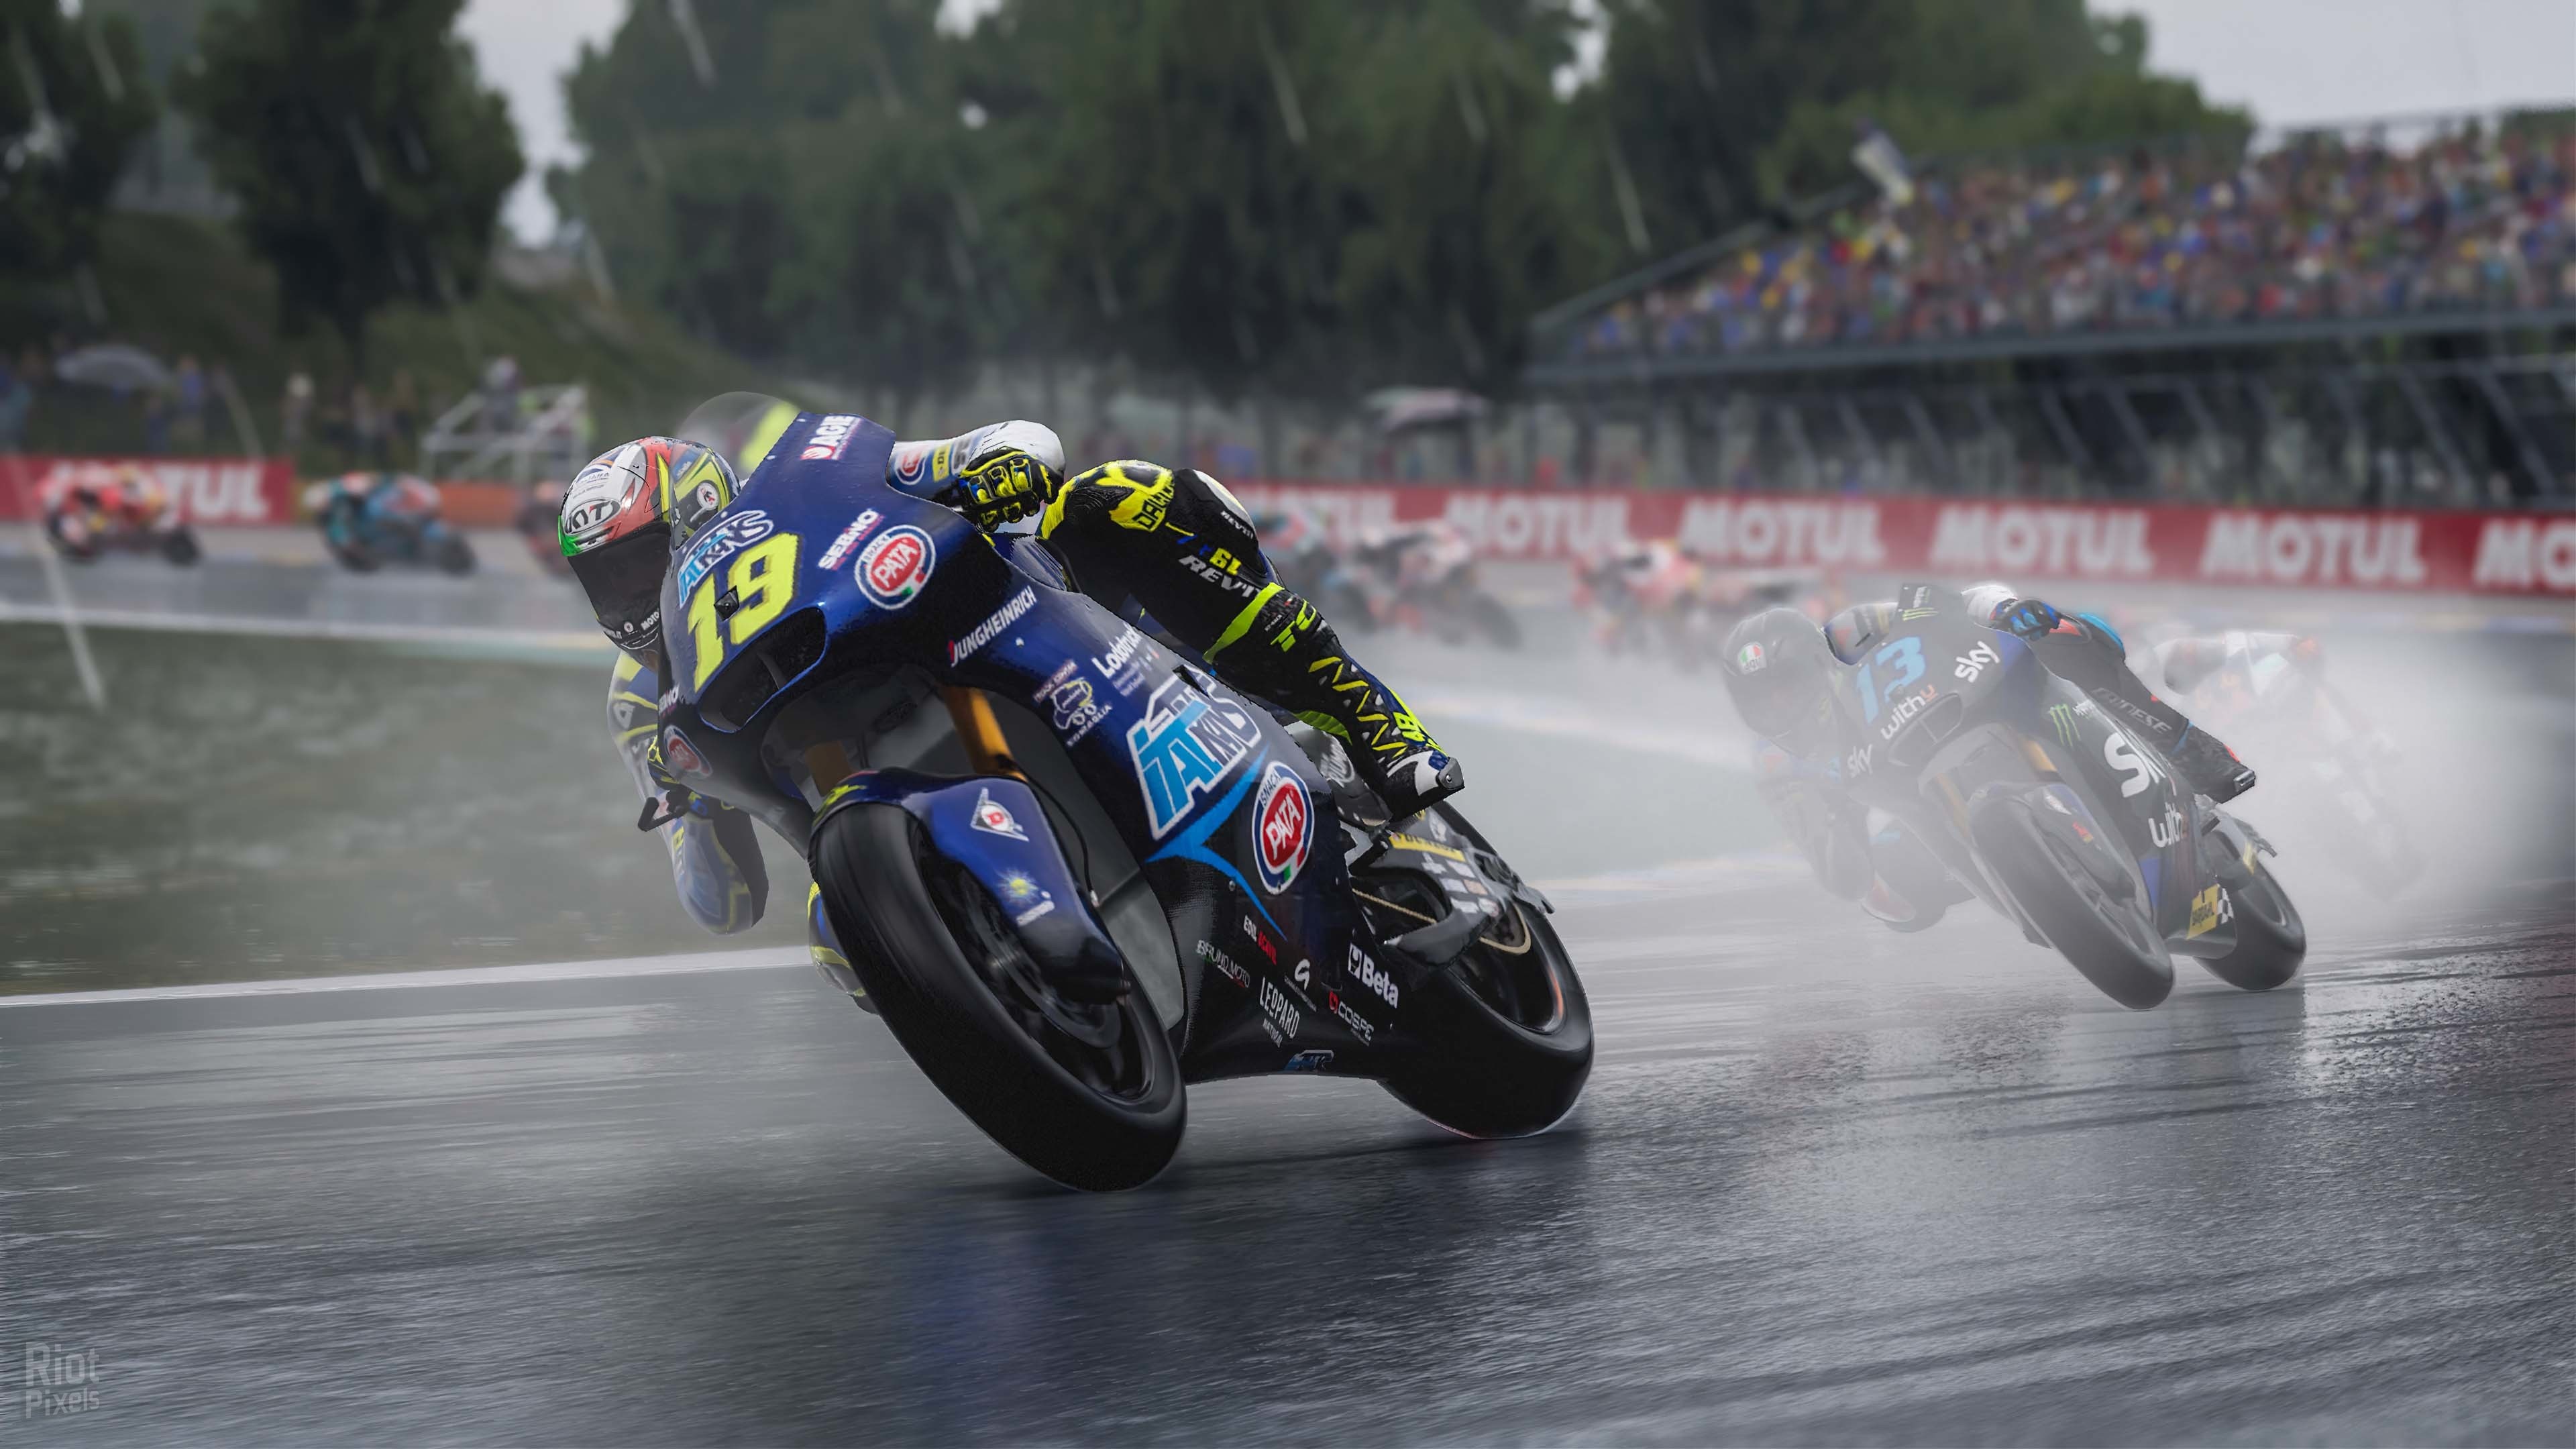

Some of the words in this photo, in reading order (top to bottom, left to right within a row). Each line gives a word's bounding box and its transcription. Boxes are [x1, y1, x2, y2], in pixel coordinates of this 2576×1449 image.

[1442, 493, 1631, 557] MOTUL
[1679, 496, 1886, 561] MOTUL
[1928, 506, 2155, 572] MOTUL
[2200, 511, 2429, 580] MOTUL
[873, 539, 918, 588] PATA
[688, 532, 801, 692] 19
[948, 586, 1037, 667] JUNGHEINRICH
[1857, 636, 1927, 724] 13
[1954, 641, 2000, 683] sky
[1847, 744, 1873, 779] sky
[1268, 794, 1302, 855] PATA
[1260, 976, 1300, 1039] LEOPARD
[1362, 953, 1399, 1009] Beta
